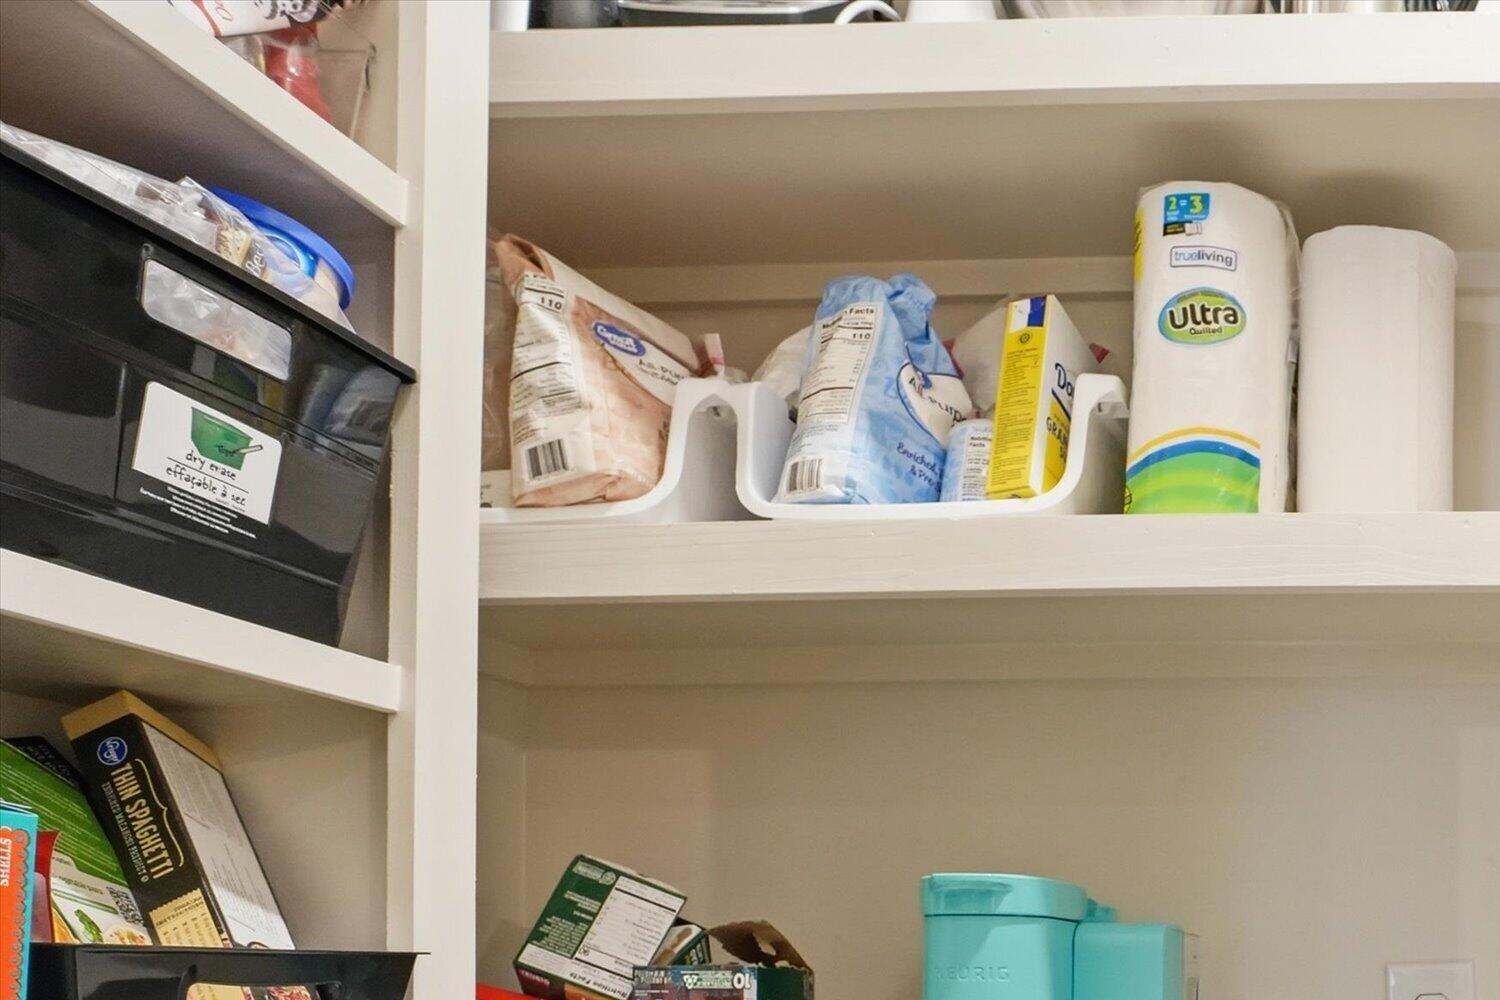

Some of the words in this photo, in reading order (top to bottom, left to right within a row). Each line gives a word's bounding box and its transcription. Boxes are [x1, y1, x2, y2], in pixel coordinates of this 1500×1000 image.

[1169, 196, 1177, 210] 2
[1190, 195, 1203, 214] 3
[1169, 304, 1239, 330] Ultra
[186, 450, 206, 470] dry
[210, 462, 237, 481] erase
[110, 762, 141, 800] THIN
[126, 798, 175, 880] SPAGHETTI
[733, 972, 752, 990] 10
[934, 966, 1009, 983] KEURIG
